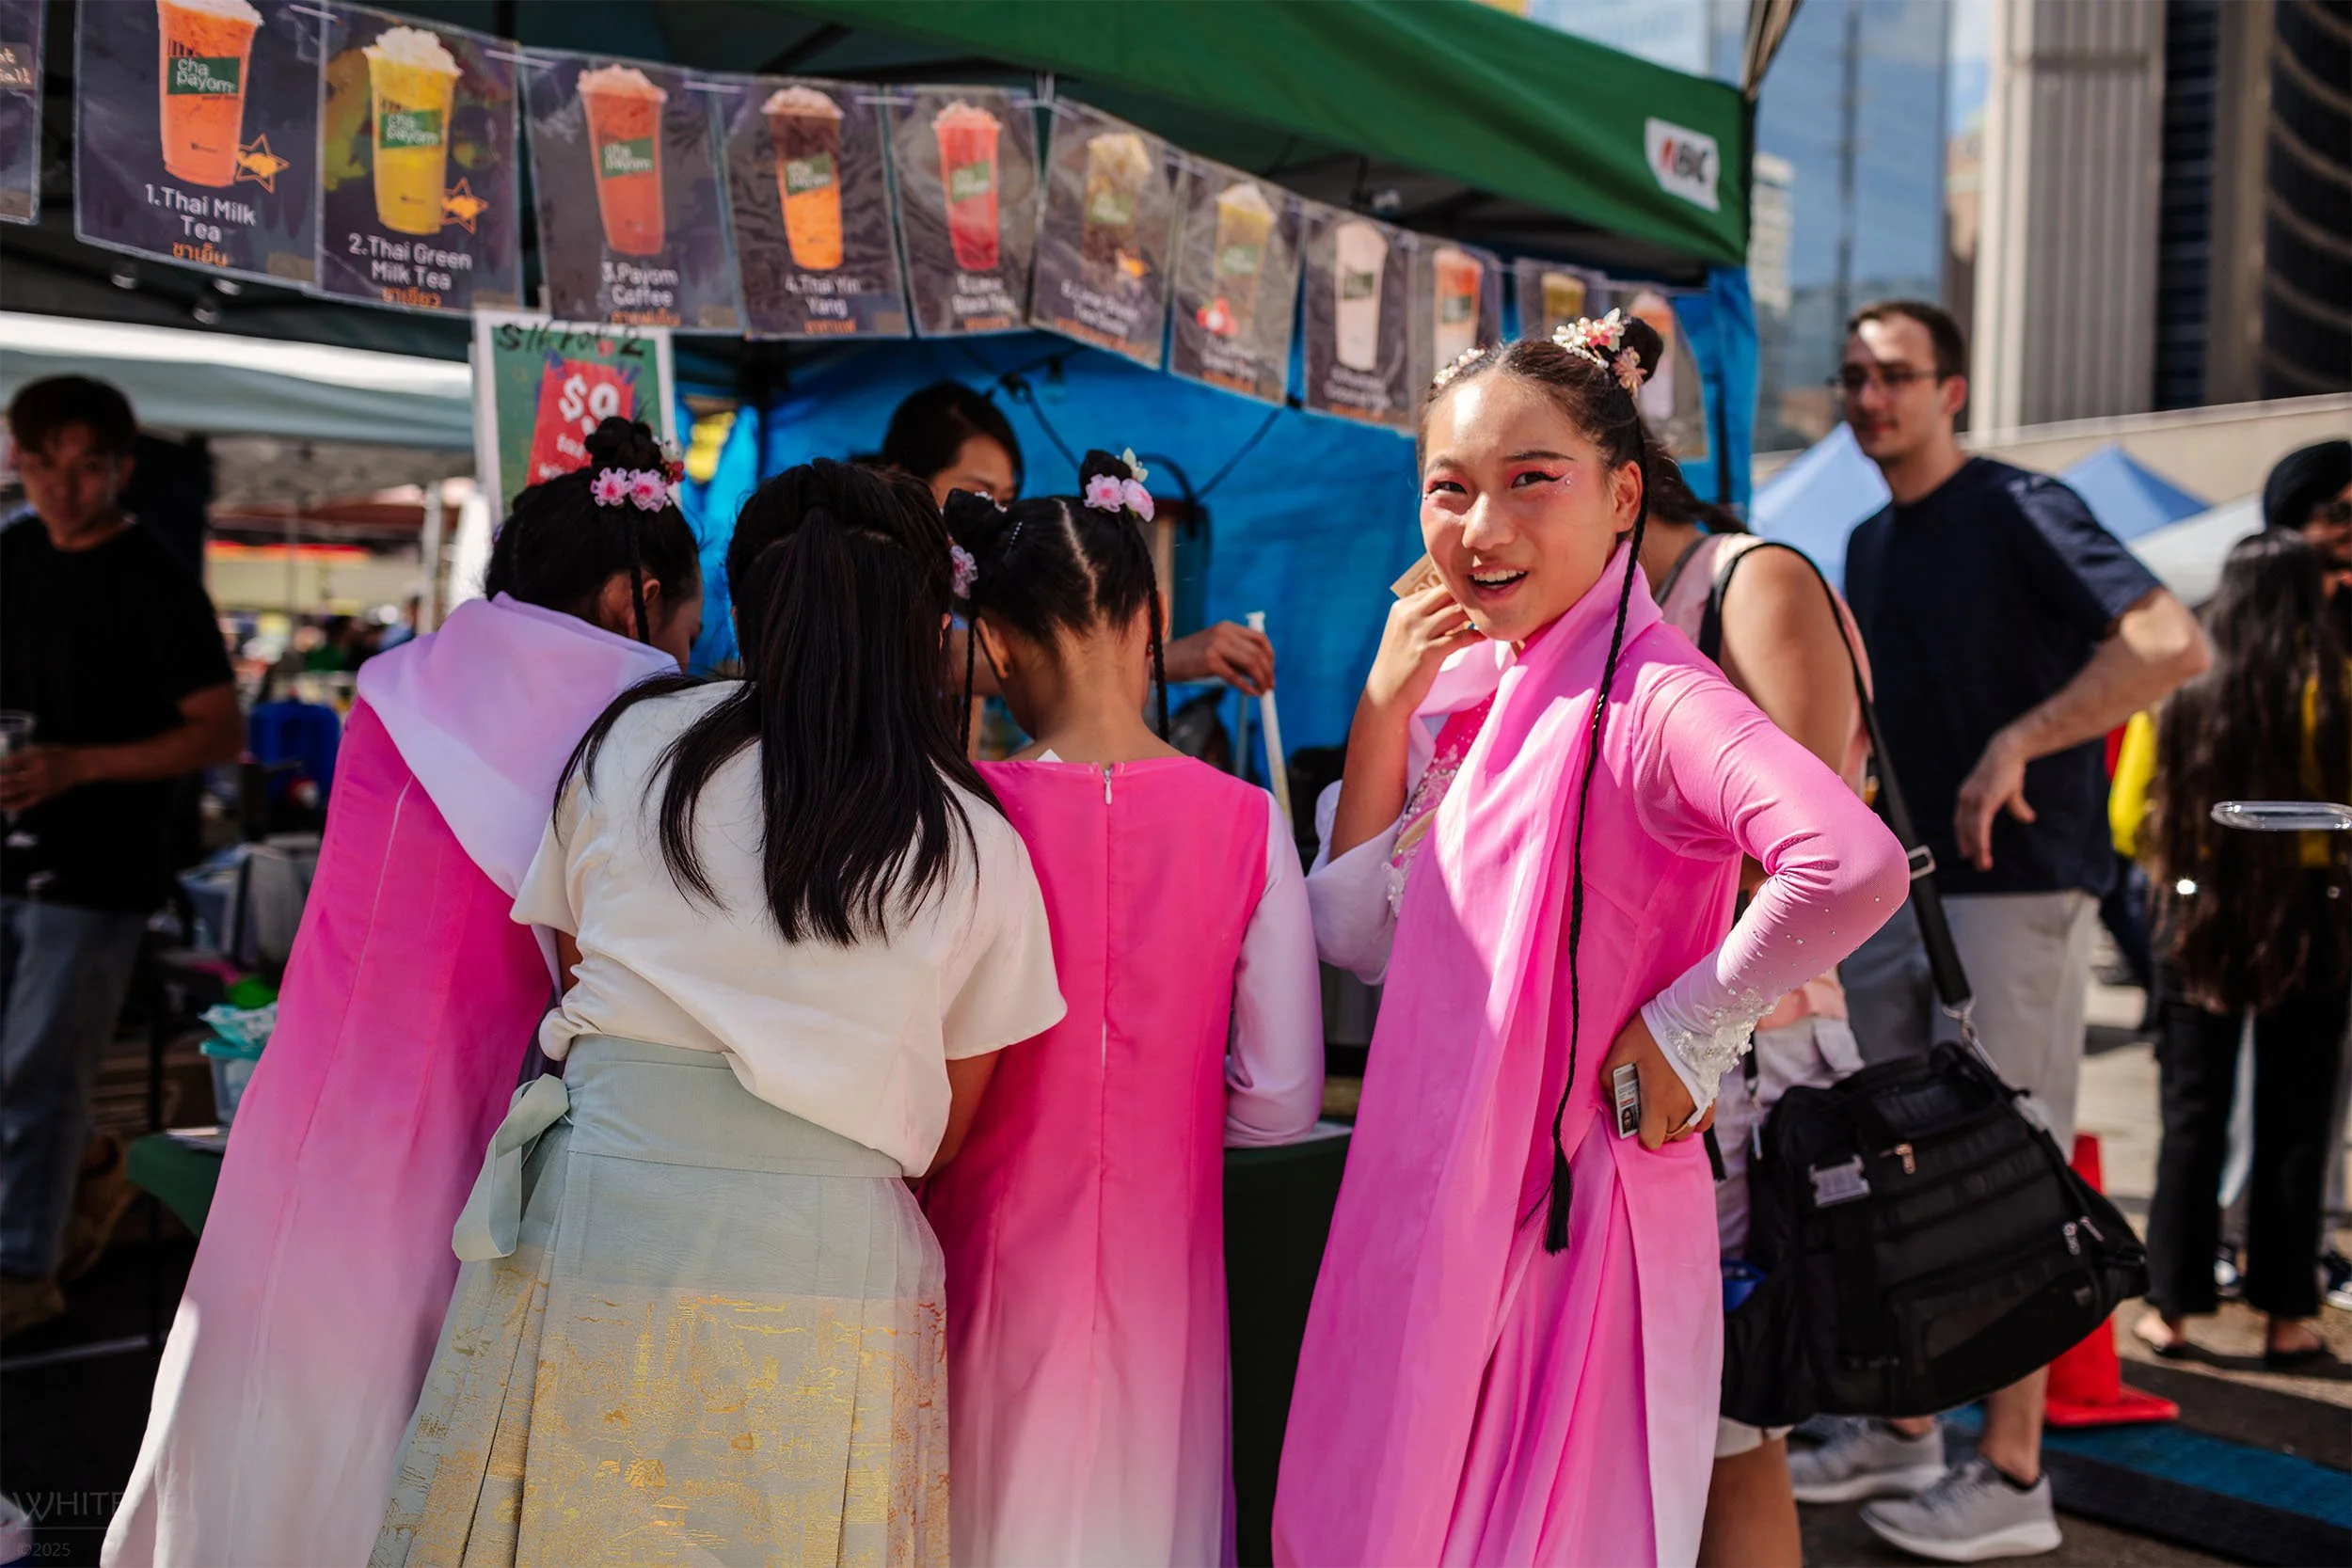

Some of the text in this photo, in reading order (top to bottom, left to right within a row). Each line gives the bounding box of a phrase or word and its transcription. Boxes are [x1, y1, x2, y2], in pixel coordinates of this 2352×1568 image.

[177, 56, 209, 76] cha
[176, 70, 236, 92] payom
[145, 183, 257, 227] 1.Thai Milk
[180, 214, 222, 243] Tea
[348, 232, 472, 271] 2.Thai Green
[372, 260, 452, 291] Milk Tea
[612, 283, 674, 308] Coffee
